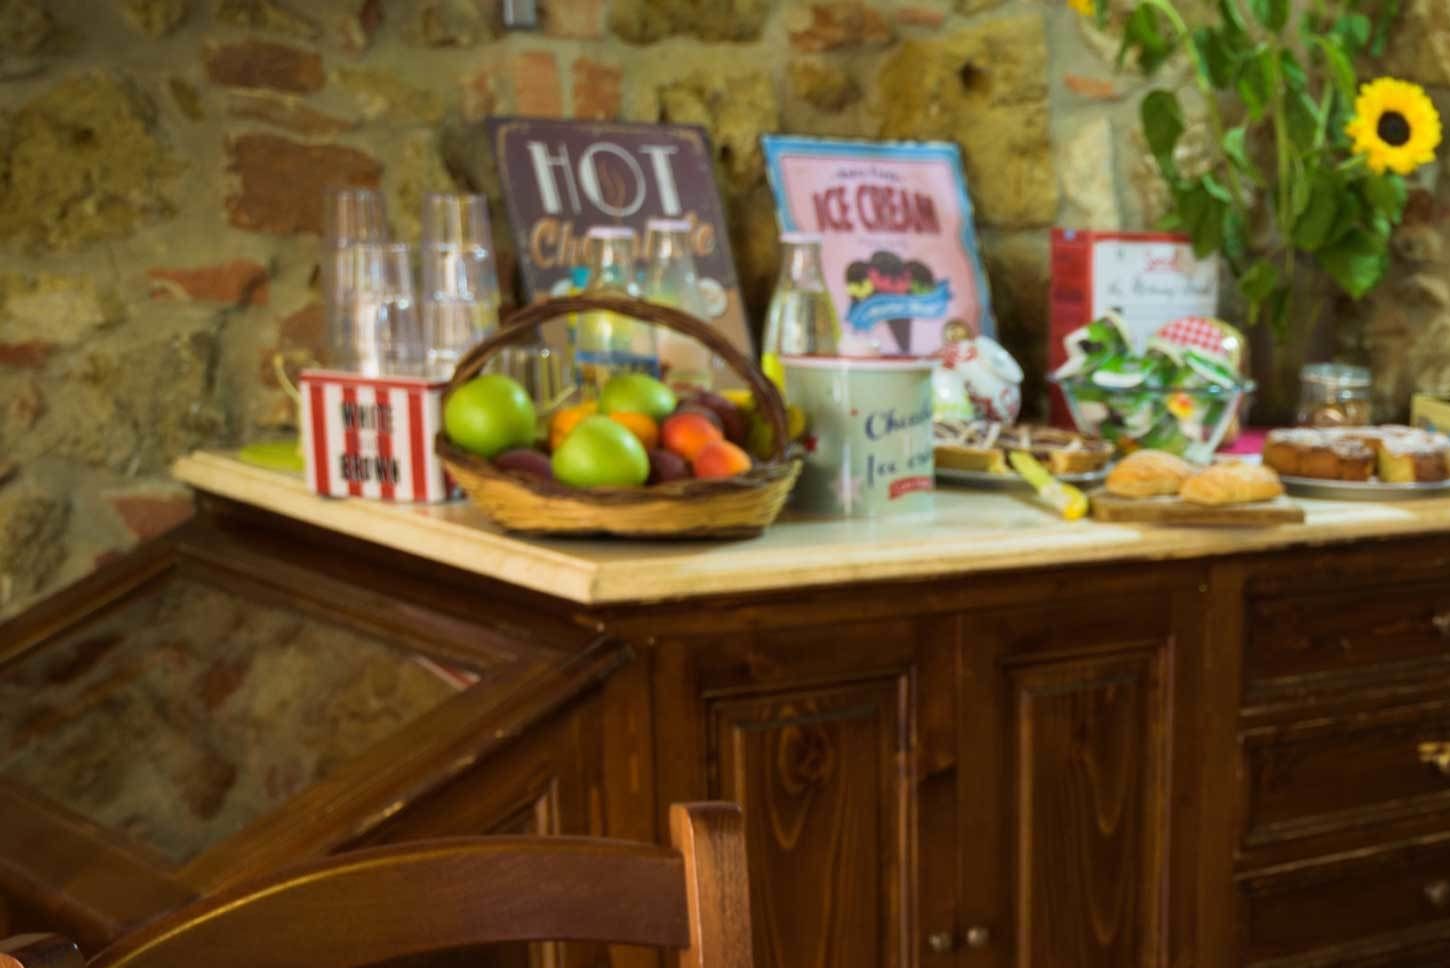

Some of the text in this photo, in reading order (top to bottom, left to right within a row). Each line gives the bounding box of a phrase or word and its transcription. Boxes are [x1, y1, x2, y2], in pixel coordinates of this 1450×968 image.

[527, 141, 682, 217] HOT
[812, 182, 942, 235] ICE CREAM
